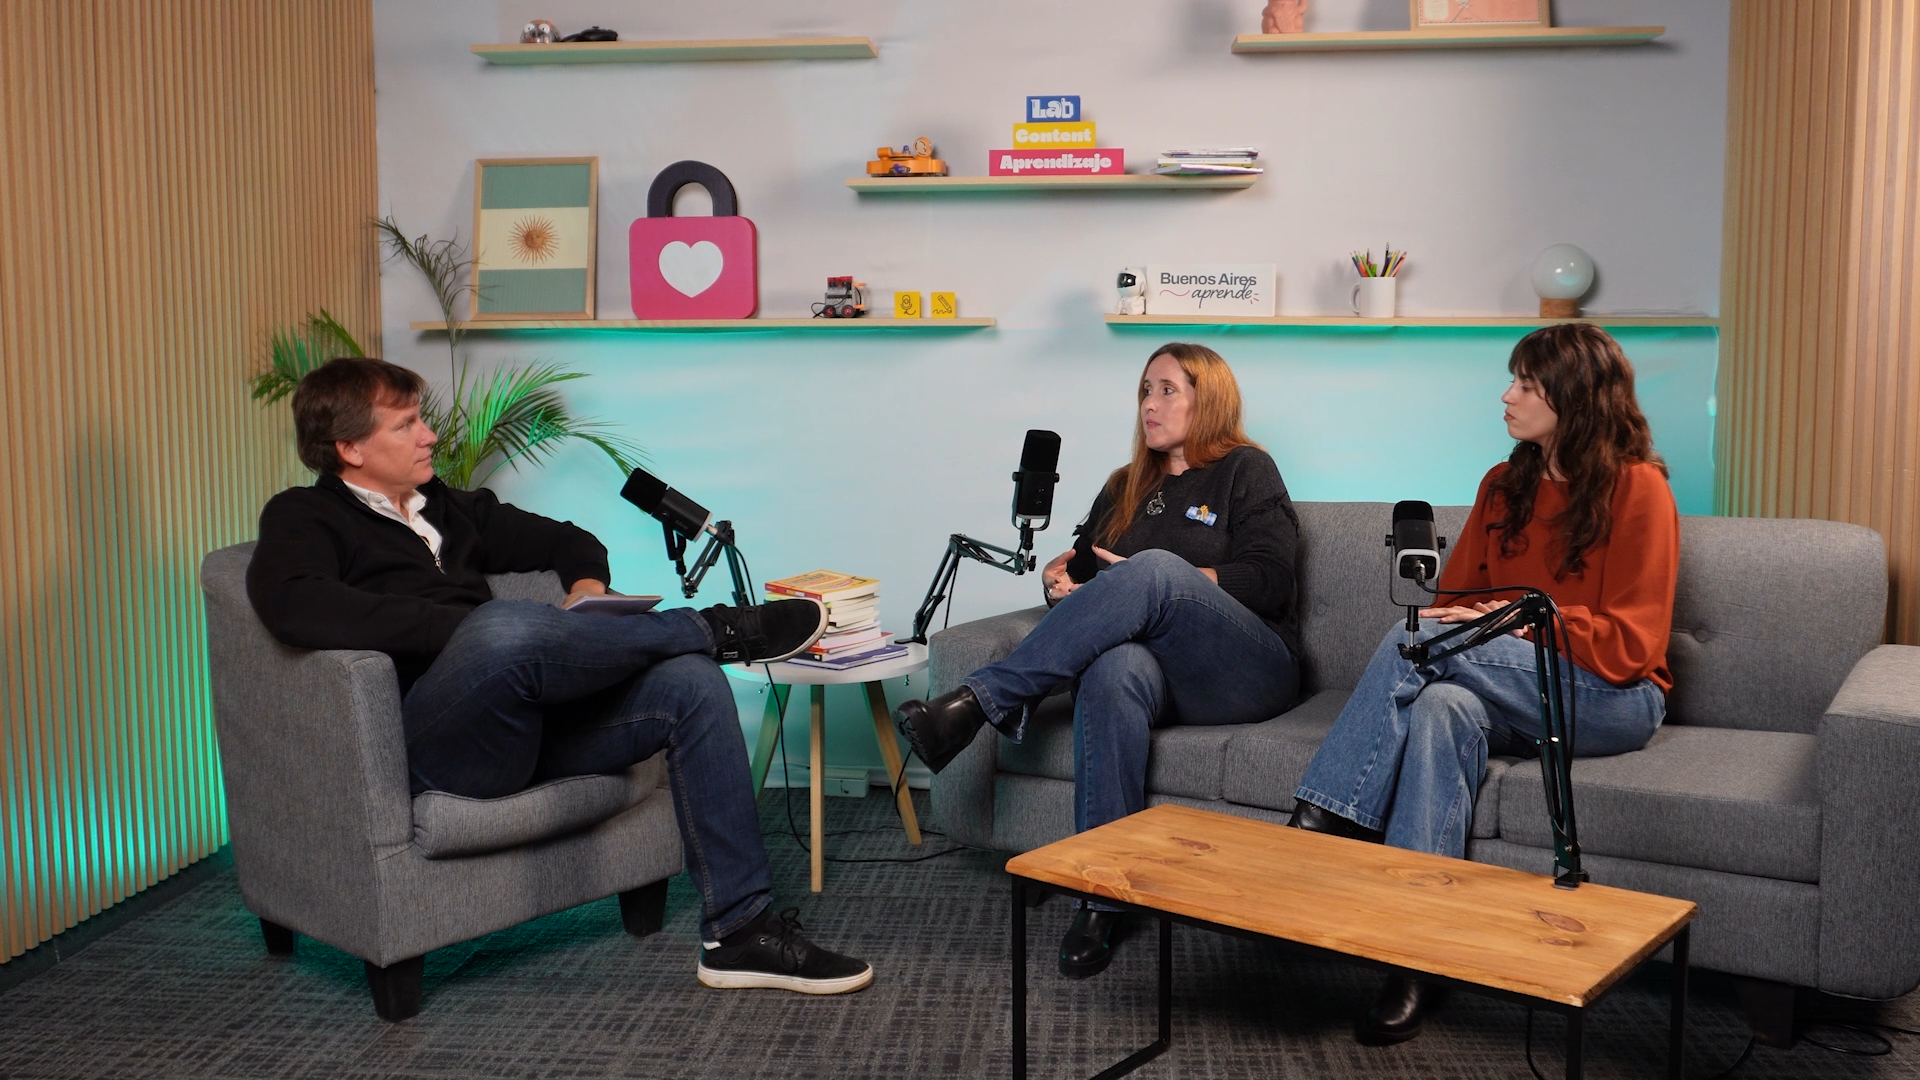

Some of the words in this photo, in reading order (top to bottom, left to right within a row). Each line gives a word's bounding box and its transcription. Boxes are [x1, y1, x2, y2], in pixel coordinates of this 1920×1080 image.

[1031, 98, 1074, 119] Lab
[1015, 128, 1092, 143] Content
[1000, 153, 1112, 172] Aprendizaje
[1160, 272, 1216, 286] Buenos
[1218, 273, 1257, 286] Aires
[1191, 277, 1253, 309] aprende
